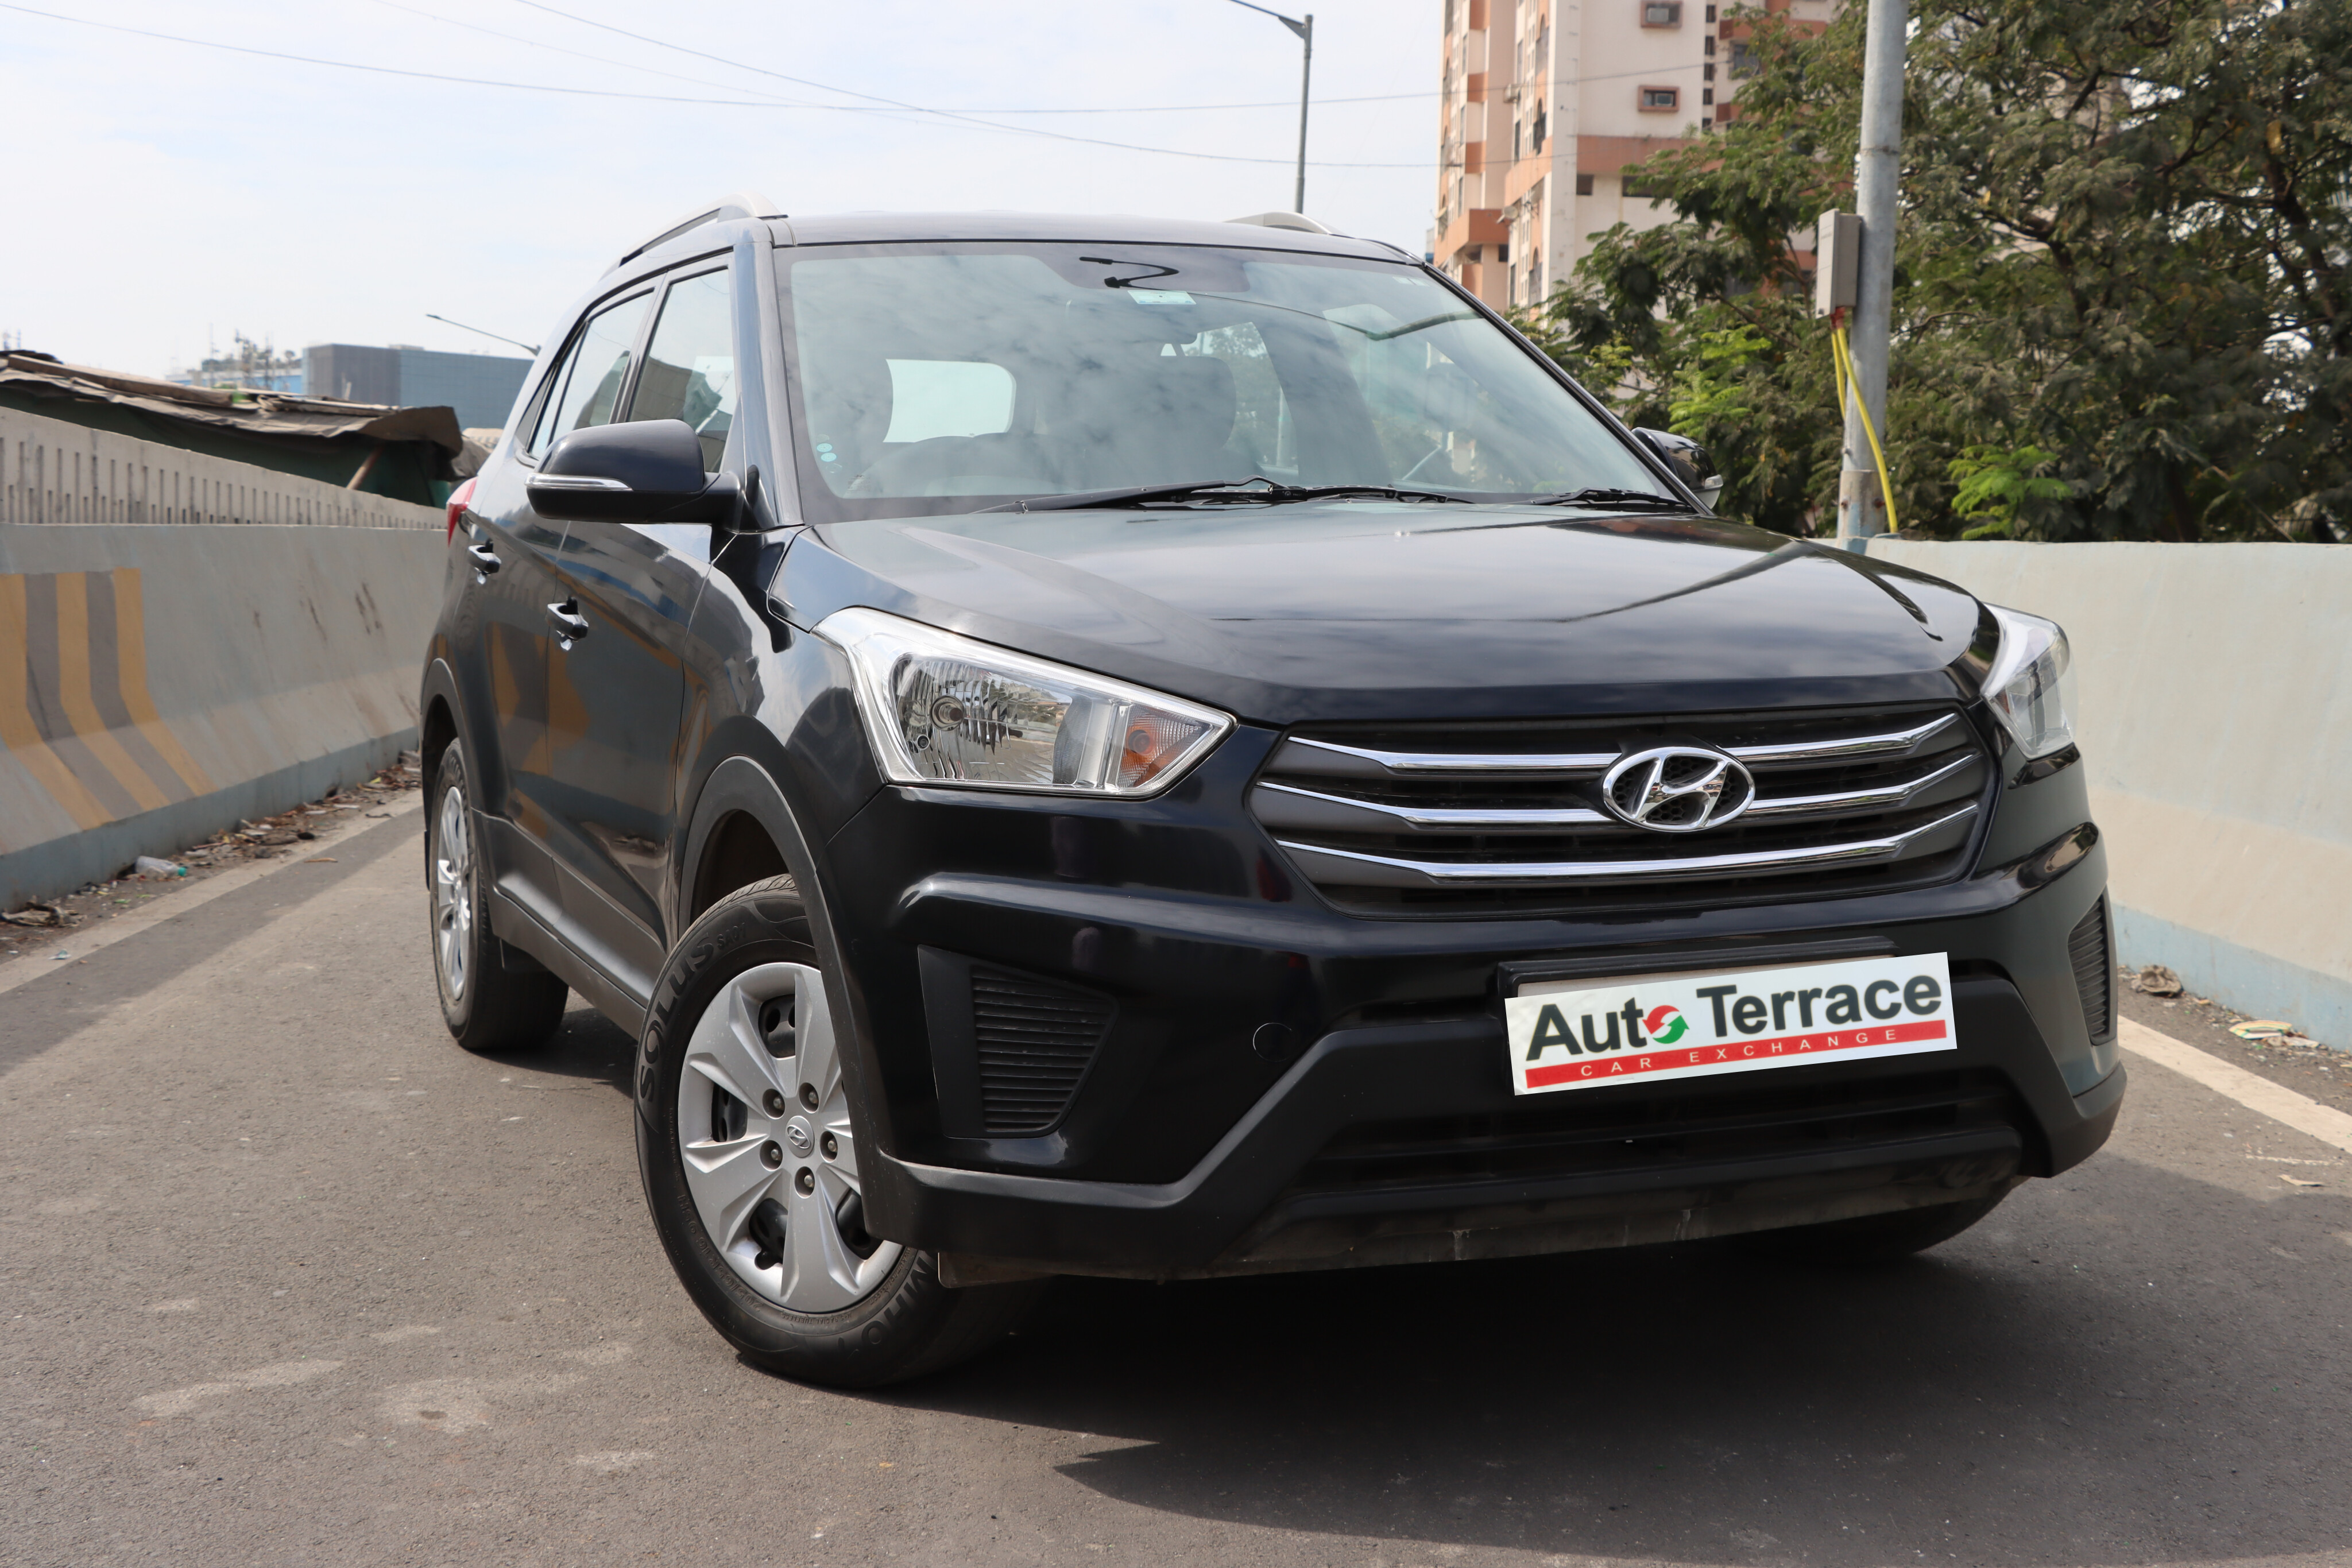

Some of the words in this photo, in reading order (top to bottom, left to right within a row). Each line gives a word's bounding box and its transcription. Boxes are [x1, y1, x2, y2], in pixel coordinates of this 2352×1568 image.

[640, 932, 714, 1102] SOLUS
[1696, 974, 1942, 1038] Terrace
[1580, 1057, 1651, 1077] CAR
[1689, 1029, 1897, 1063] EXCHANGE
[782, 1311, 812, 1325] TUBELESS
[815, 1315, 838, 1326] RADIAL
